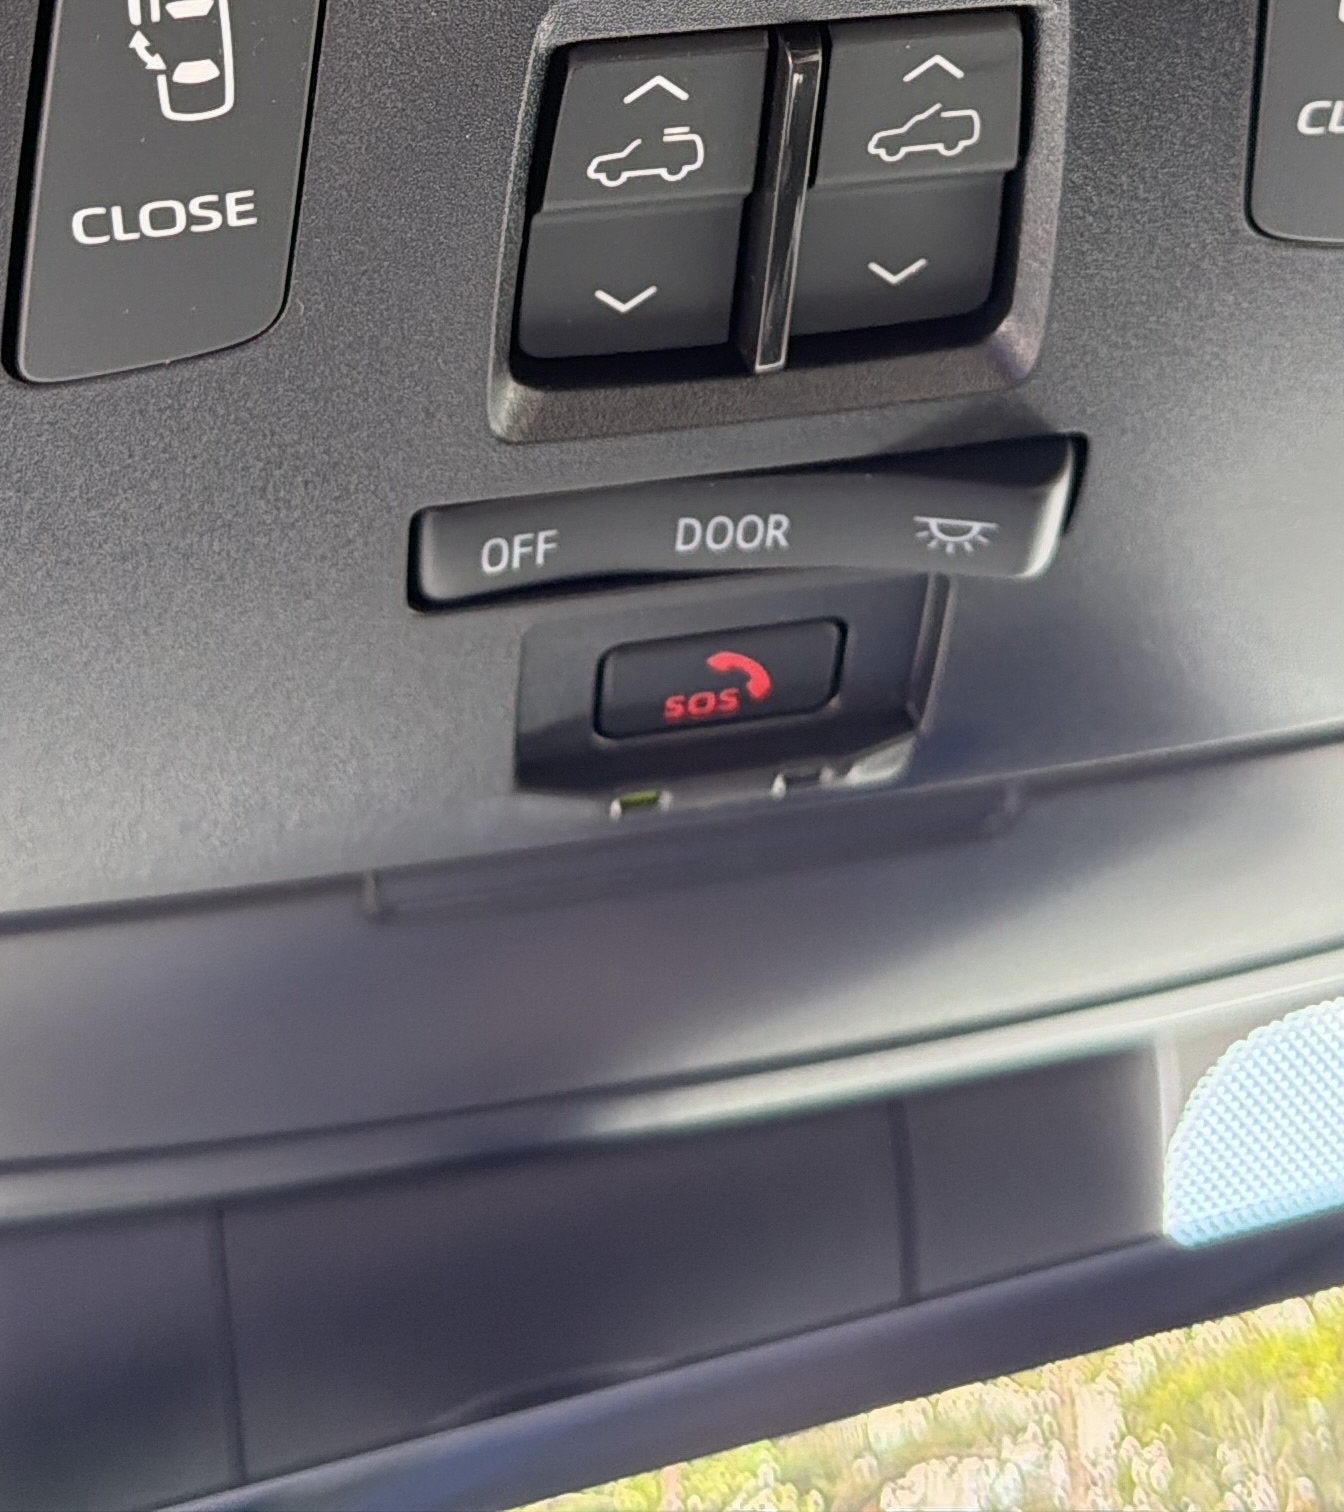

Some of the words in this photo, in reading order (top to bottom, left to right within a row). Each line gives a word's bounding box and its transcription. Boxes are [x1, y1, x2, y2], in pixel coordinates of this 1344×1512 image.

[71, 189, 258, 245] CLOSE
[481, 529, 558, 574] OFF
[674, 513, 790, 554] DOOR
[663, 687, 739, 723] SOS
